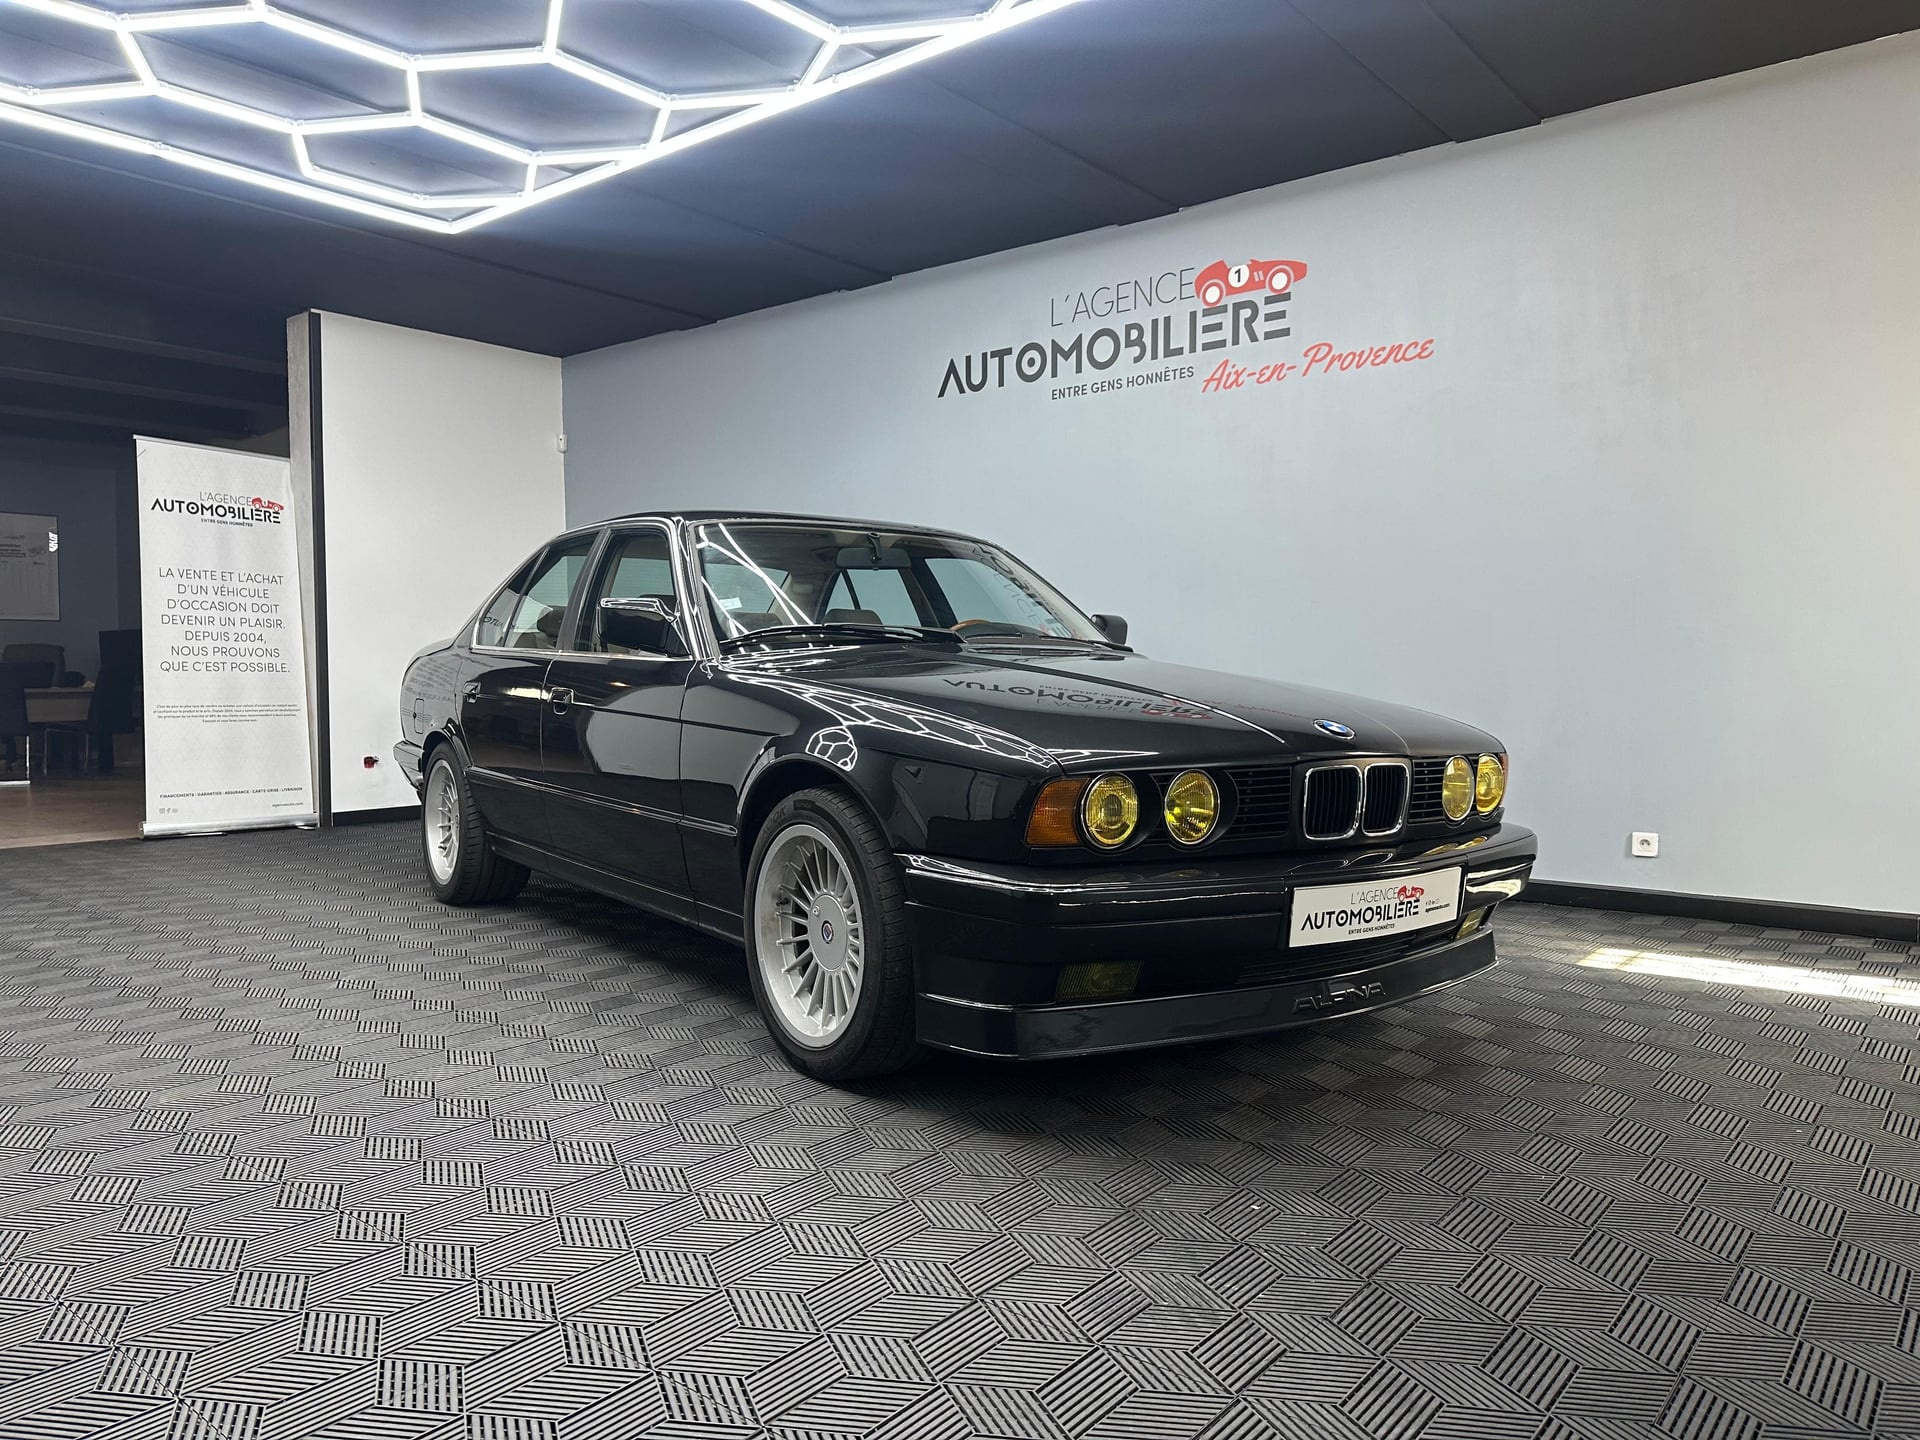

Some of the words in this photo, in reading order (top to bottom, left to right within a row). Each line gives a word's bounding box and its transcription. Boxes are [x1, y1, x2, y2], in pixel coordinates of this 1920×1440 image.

[1050, 266, 1195, 327] L'AGENCE
[1051, 384, 1088, 400] ENTRE
[1091, 379, 1123, 394] GENS
[1126, 366, 1194, 389] HONNÊTES
[199, 491, 252, 506] L'AGENCE
[159, 567, 174, 578] LA
[178, 568, 217, 581] VENTE
[221, 571, 234, 582] ET
[238, 572, 284, 585] L'ACHAT
[177, 584, 208, 596] D'UN
[212, 584, 270, 599] VÉHICULE
[167, 599, 247, 613] D'OCCASION
[251, 602, 280, 614] DOIT
[161, 614, 216, 626] DEVENIR
[219, 616, 236, 627] UN
[240, 617, 286, 629] PLAISIR.
[184, 630, 230, 641] DEPUIS
[233, 632, 267, 644] 2004,
[171, 646, 208, 657] NOUS
[212, 646, 280, 658] PROUVONS
[160, 661, 189, 673] QUE
[192, 661, 227, 672] C'EST
[230, 661, 290, 673] POSSIBLE.
[1351, 886, 1398, 905] L'AGENCE
